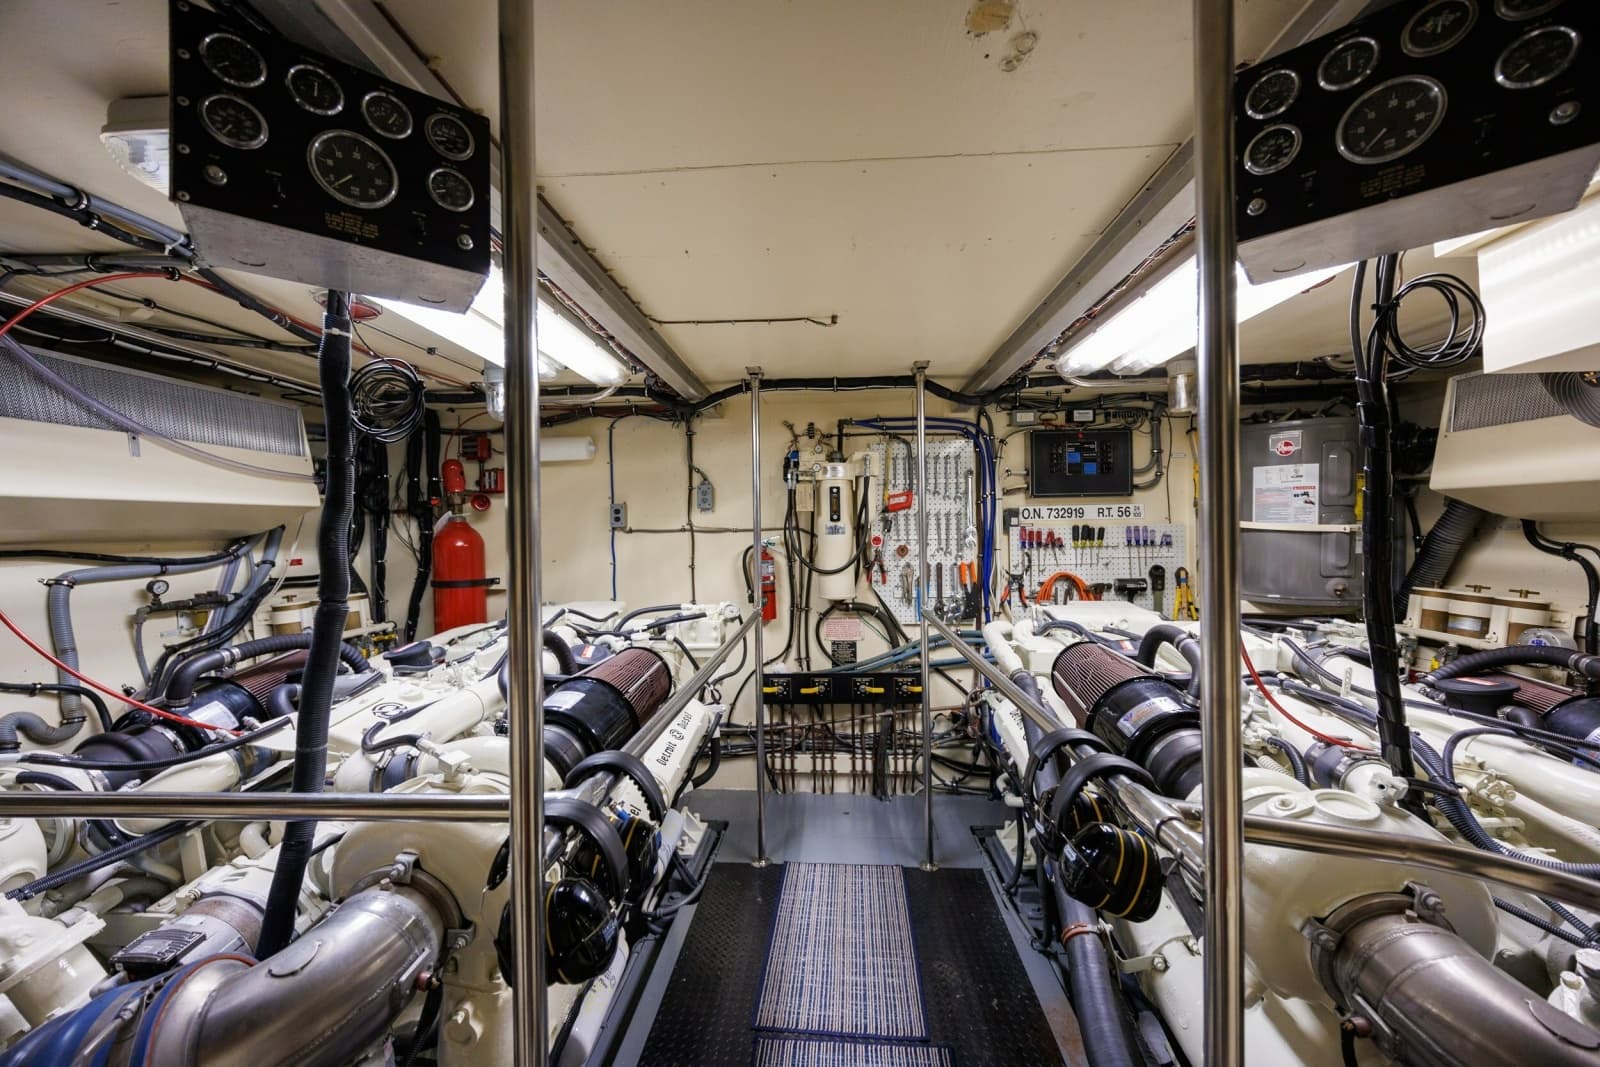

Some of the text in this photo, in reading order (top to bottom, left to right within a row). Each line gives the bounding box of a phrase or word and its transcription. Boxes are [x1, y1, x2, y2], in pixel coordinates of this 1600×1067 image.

[1021, 506, 1131, 520] O.N. 732919 R.T. 56
[656, 741, 677, 766] Detroit
